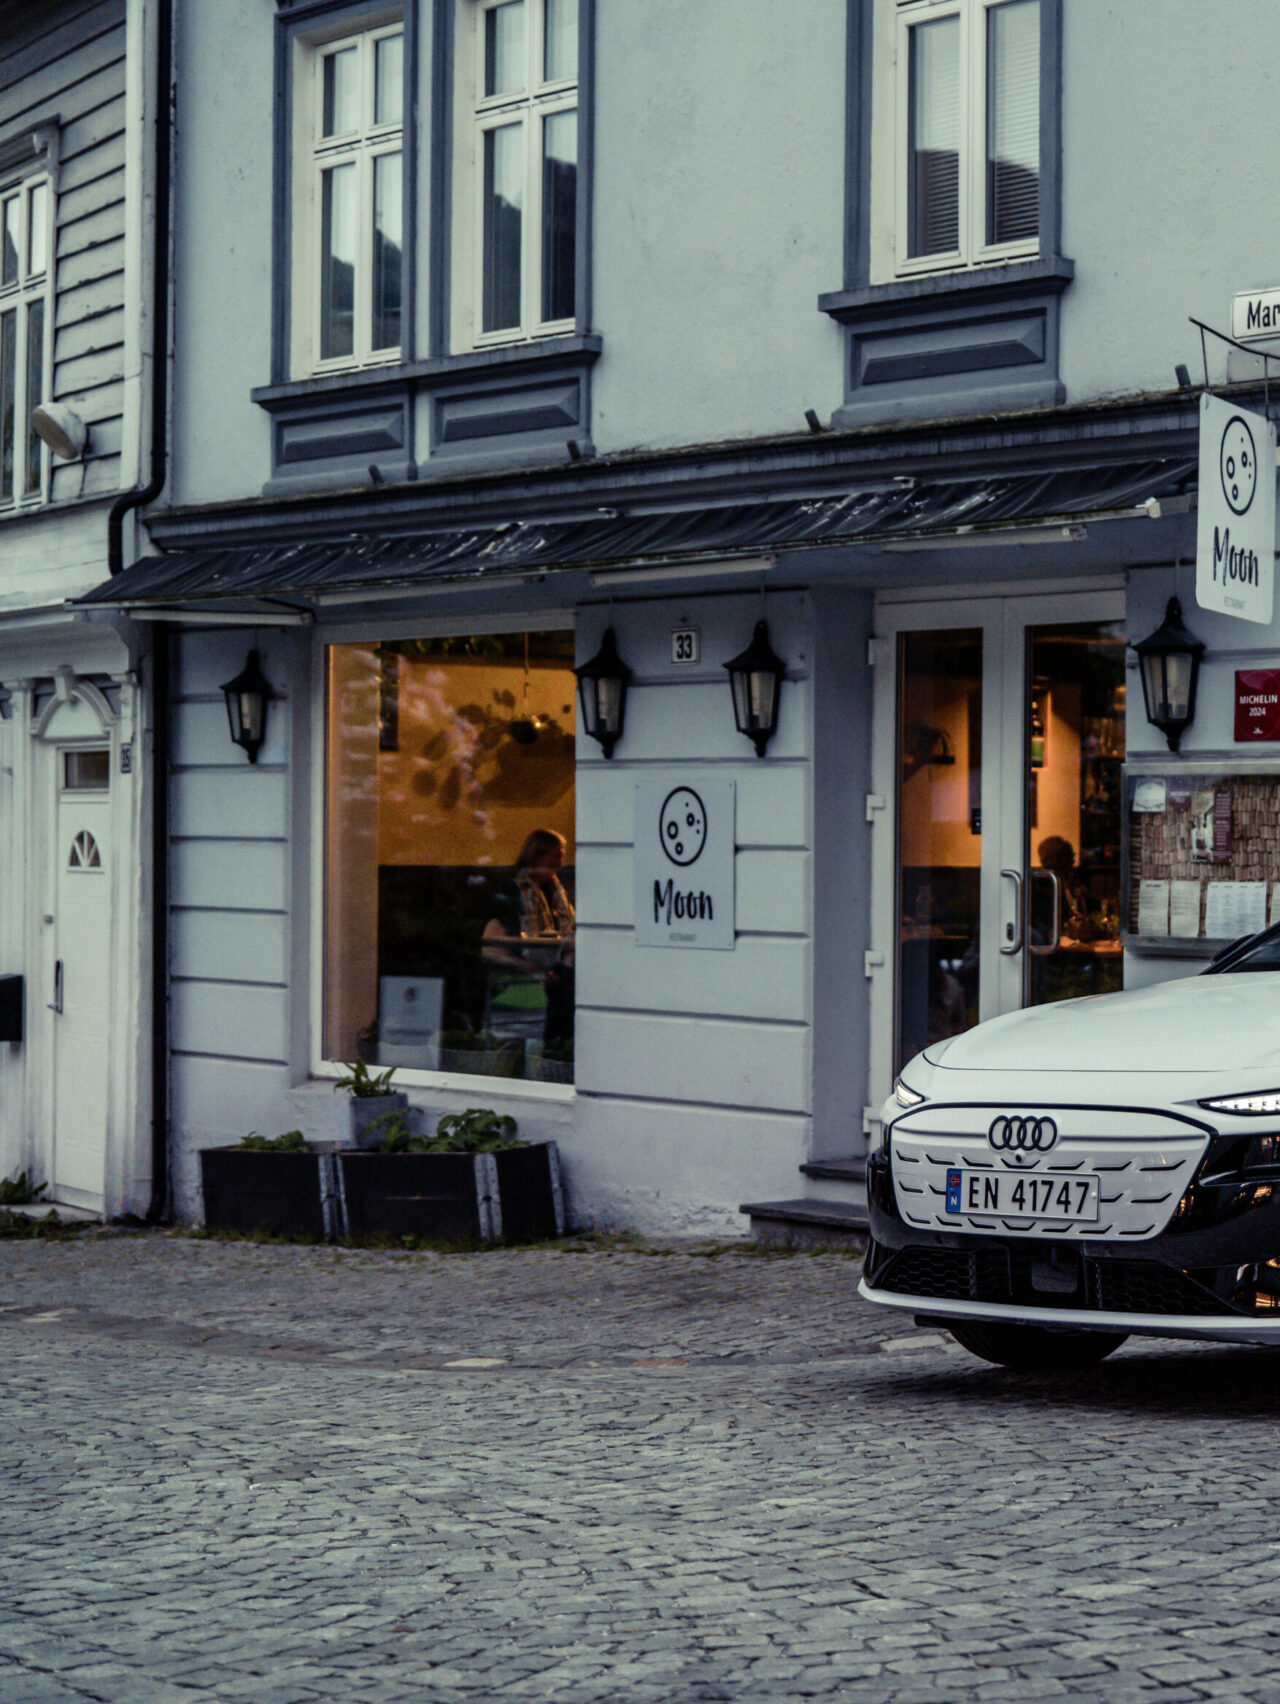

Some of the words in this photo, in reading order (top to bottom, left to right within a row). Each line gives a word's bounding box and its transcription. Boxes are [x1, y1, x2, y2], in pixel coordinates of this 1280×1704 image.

[1213, 526, 1259, 587] Moon
[676, 634, 692, 659] 33
[1239, 694, 1278, 704] MICHELIN
[1249, 707, 1266, 717] 2024
[653, 878, 713, 925] Moon
[950, 1196, 958, 1206] N
[969, 1176, 999, 1209] EN
[1011, 1178, 1090, 1214] 41747
